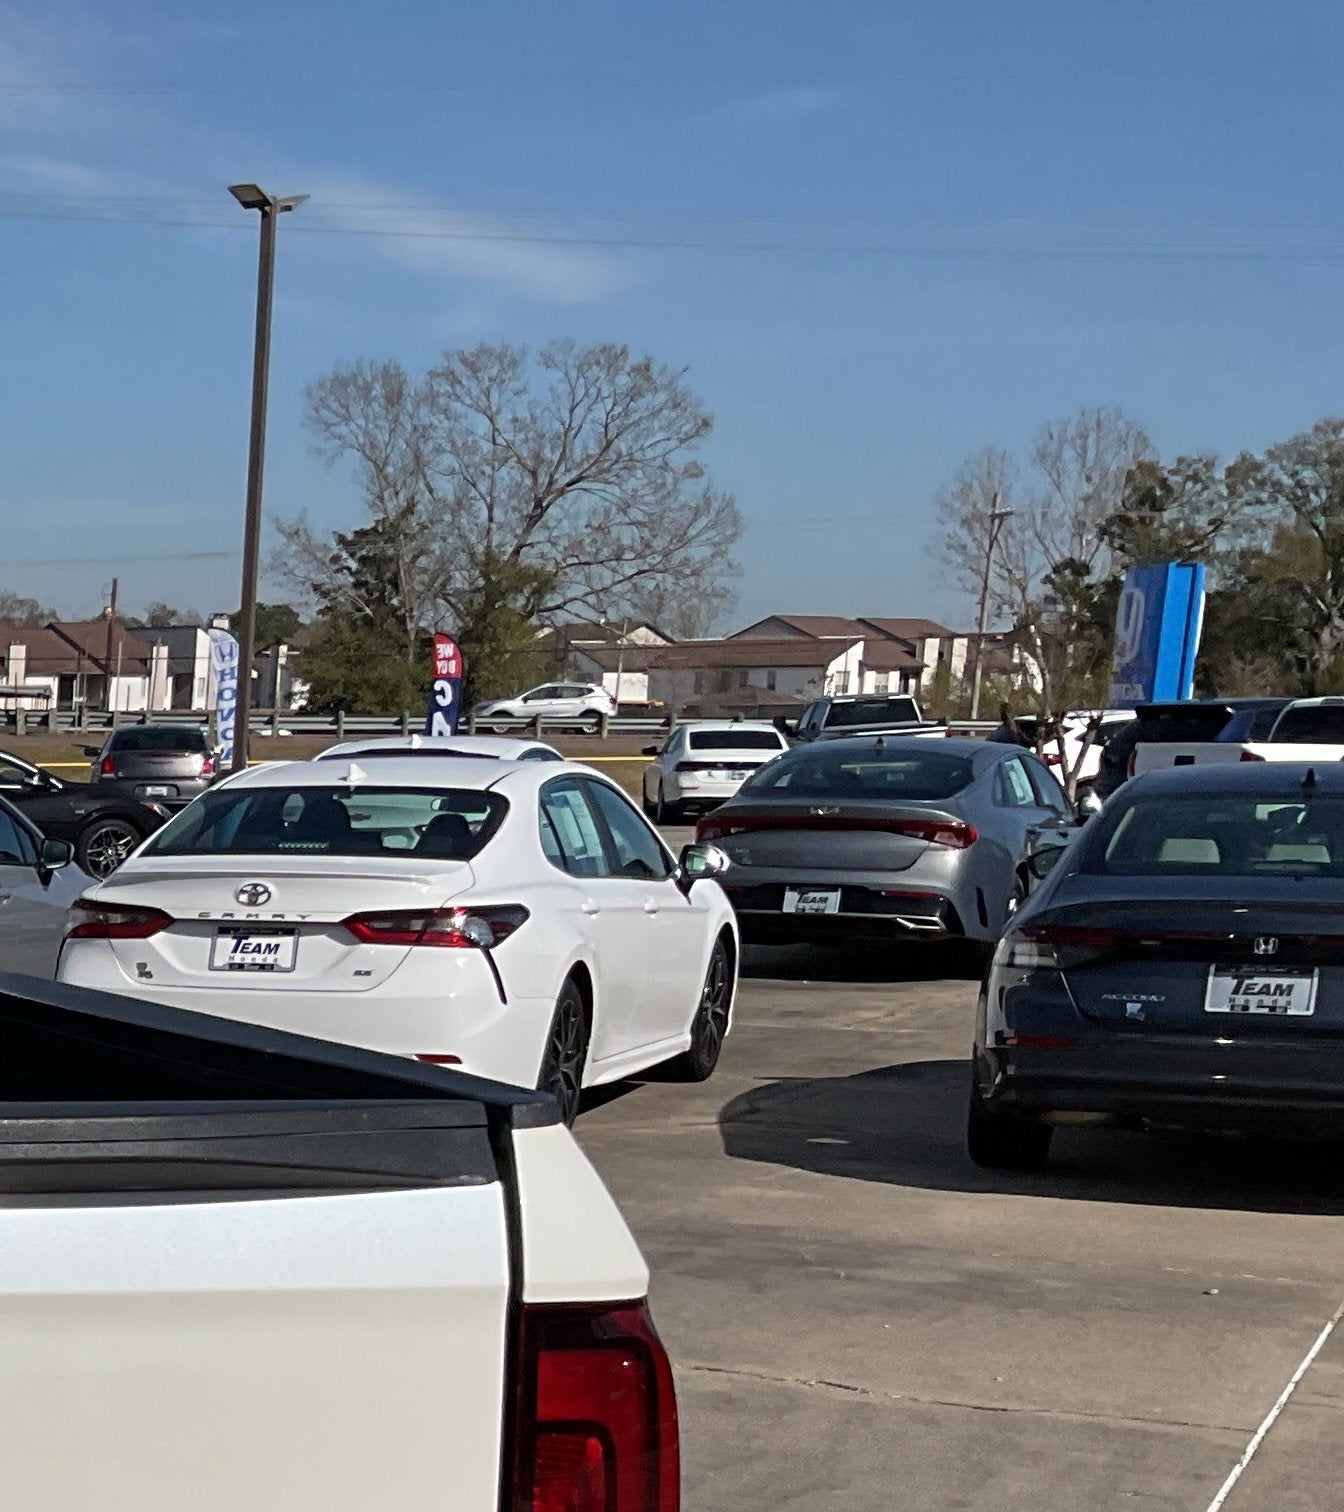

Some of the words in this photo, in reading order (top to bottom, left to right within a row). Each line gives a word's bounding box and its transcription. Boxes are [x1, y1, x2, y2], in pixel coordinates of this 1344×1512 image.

[198, 911, 312, 920] CAMRY
[231, 935, 281, 955] TEAM
[229, 955, 278, 963] Honda
[1230, 976, 1295, 997] TEAM
